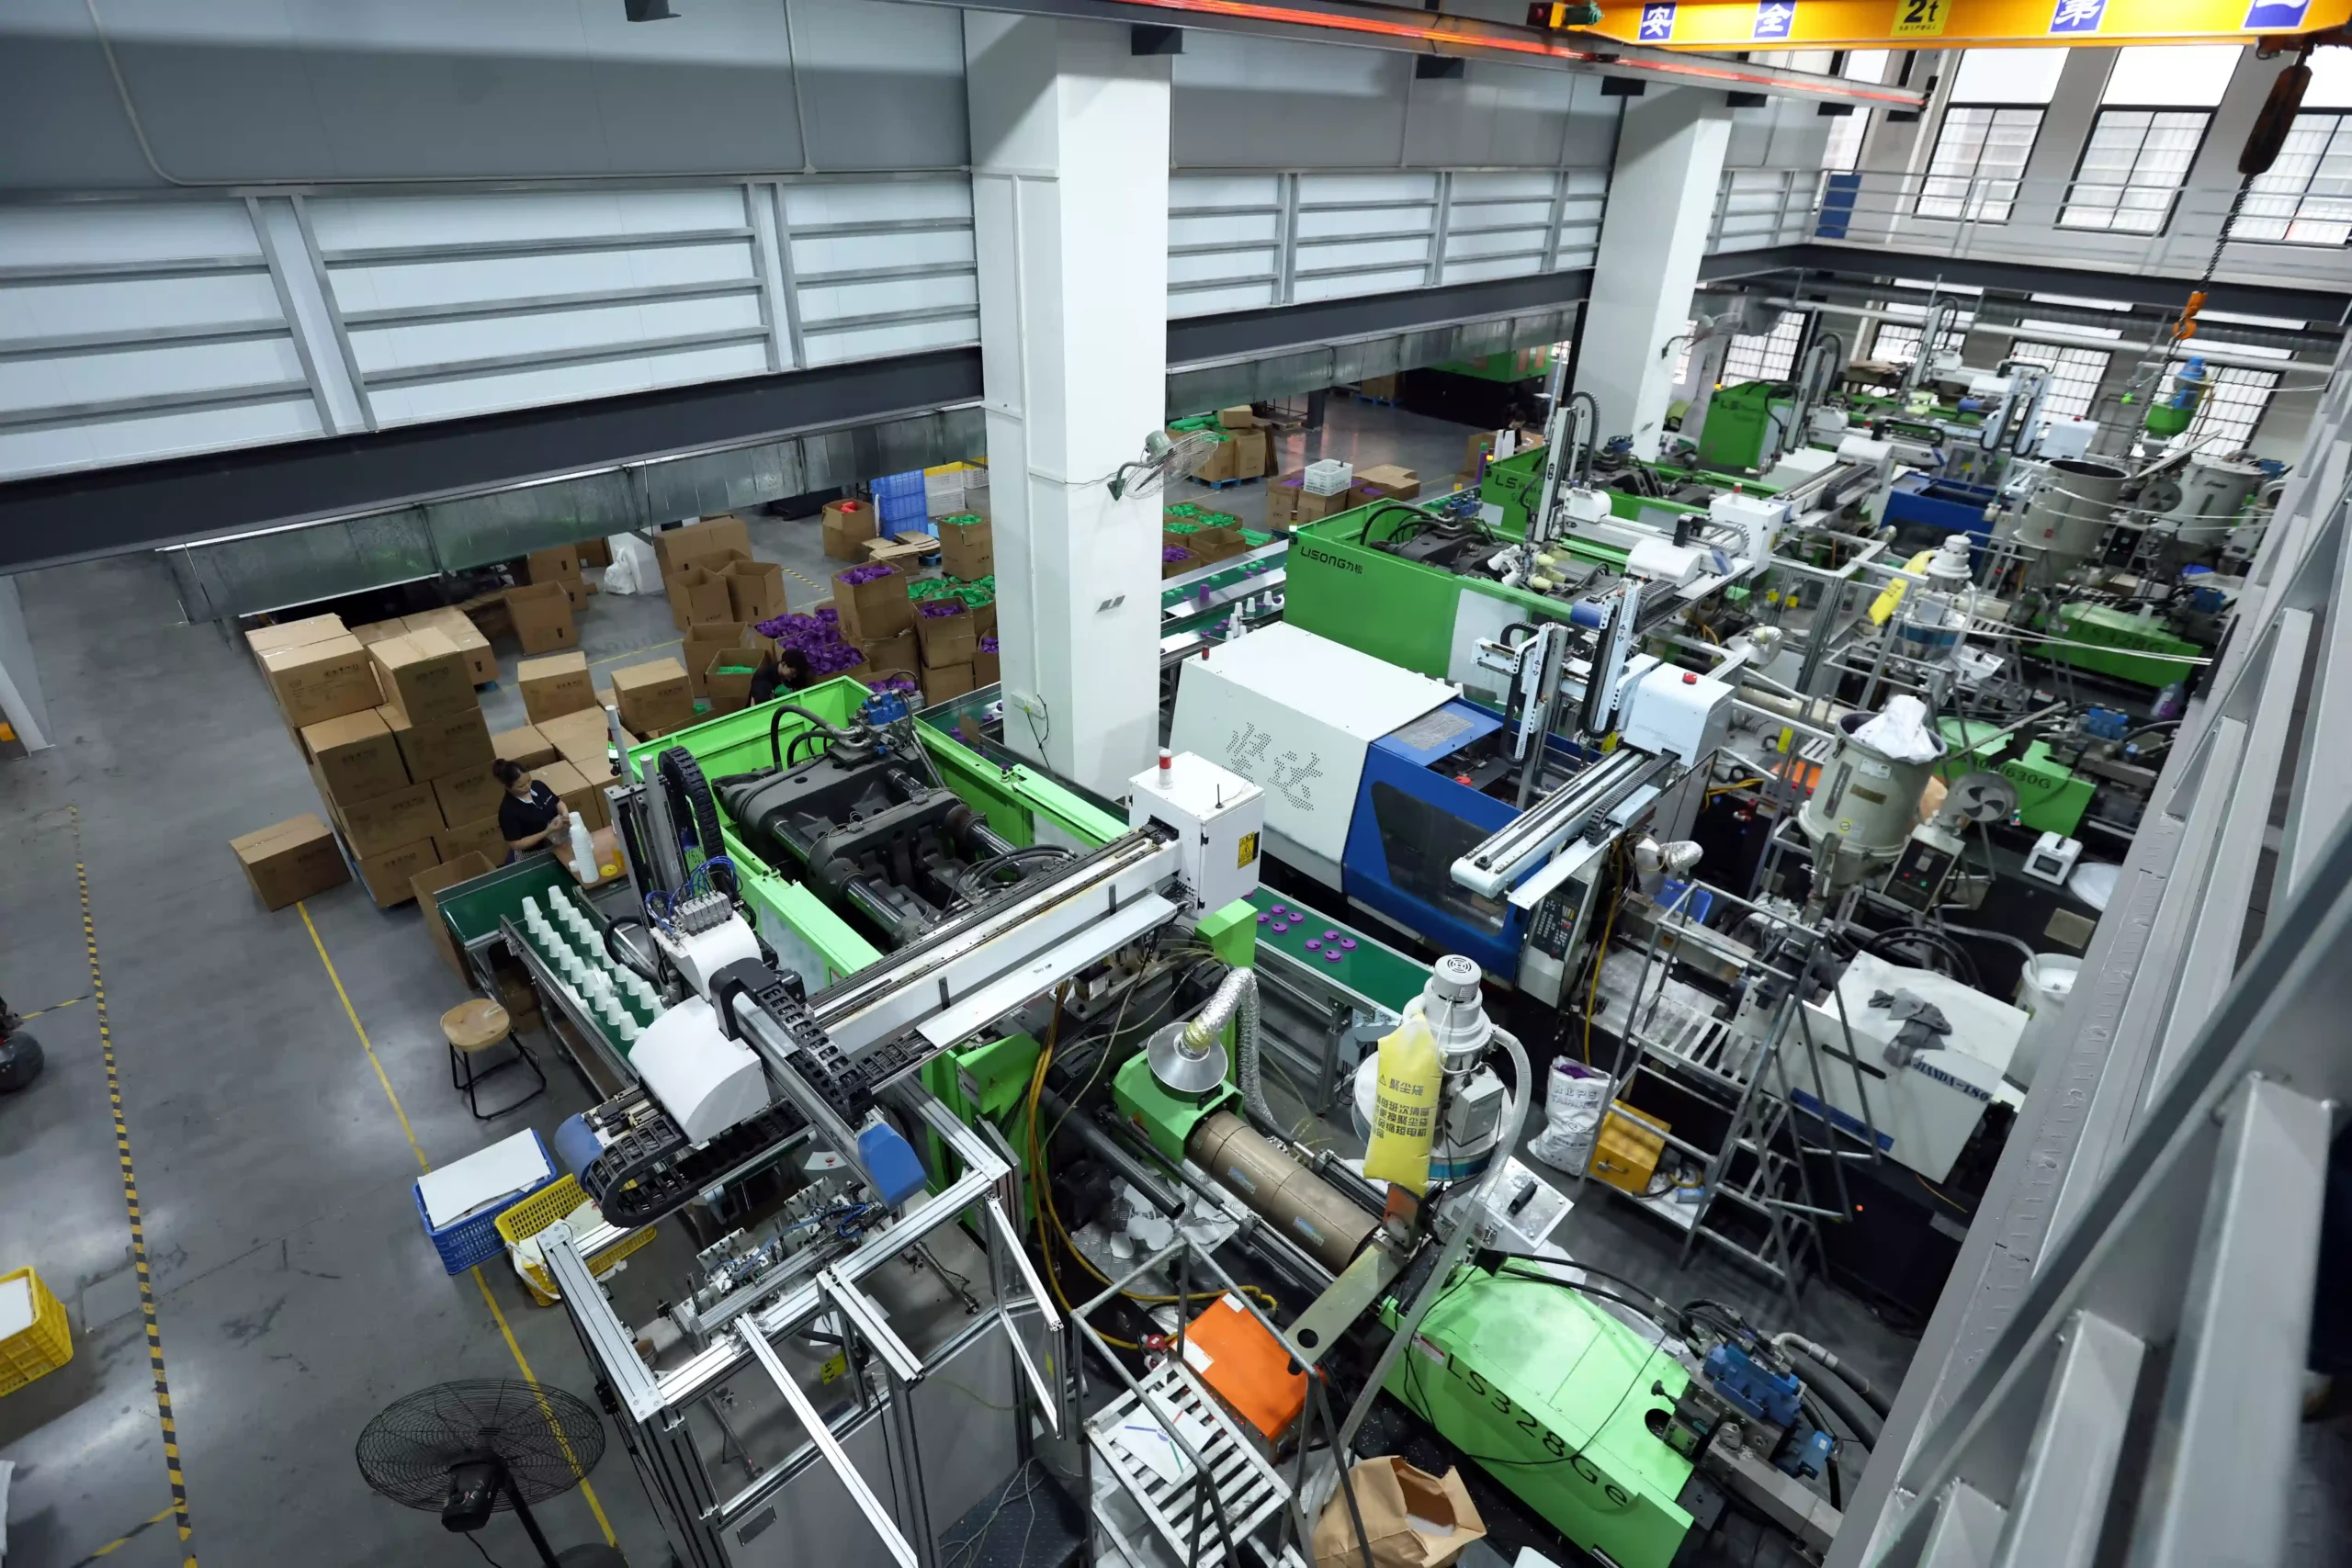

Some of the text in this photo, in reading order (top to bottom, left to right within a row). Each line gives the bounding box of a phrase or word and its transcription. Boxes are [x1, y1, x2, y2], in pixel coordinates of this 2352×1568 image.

[1641, 6, 1673, 37] 安
[1757, 3, 1792, 33] 全
[1903, 0, 1939, 24] 2t
[1446, 1352, 1628, 1507] LS328Ge
